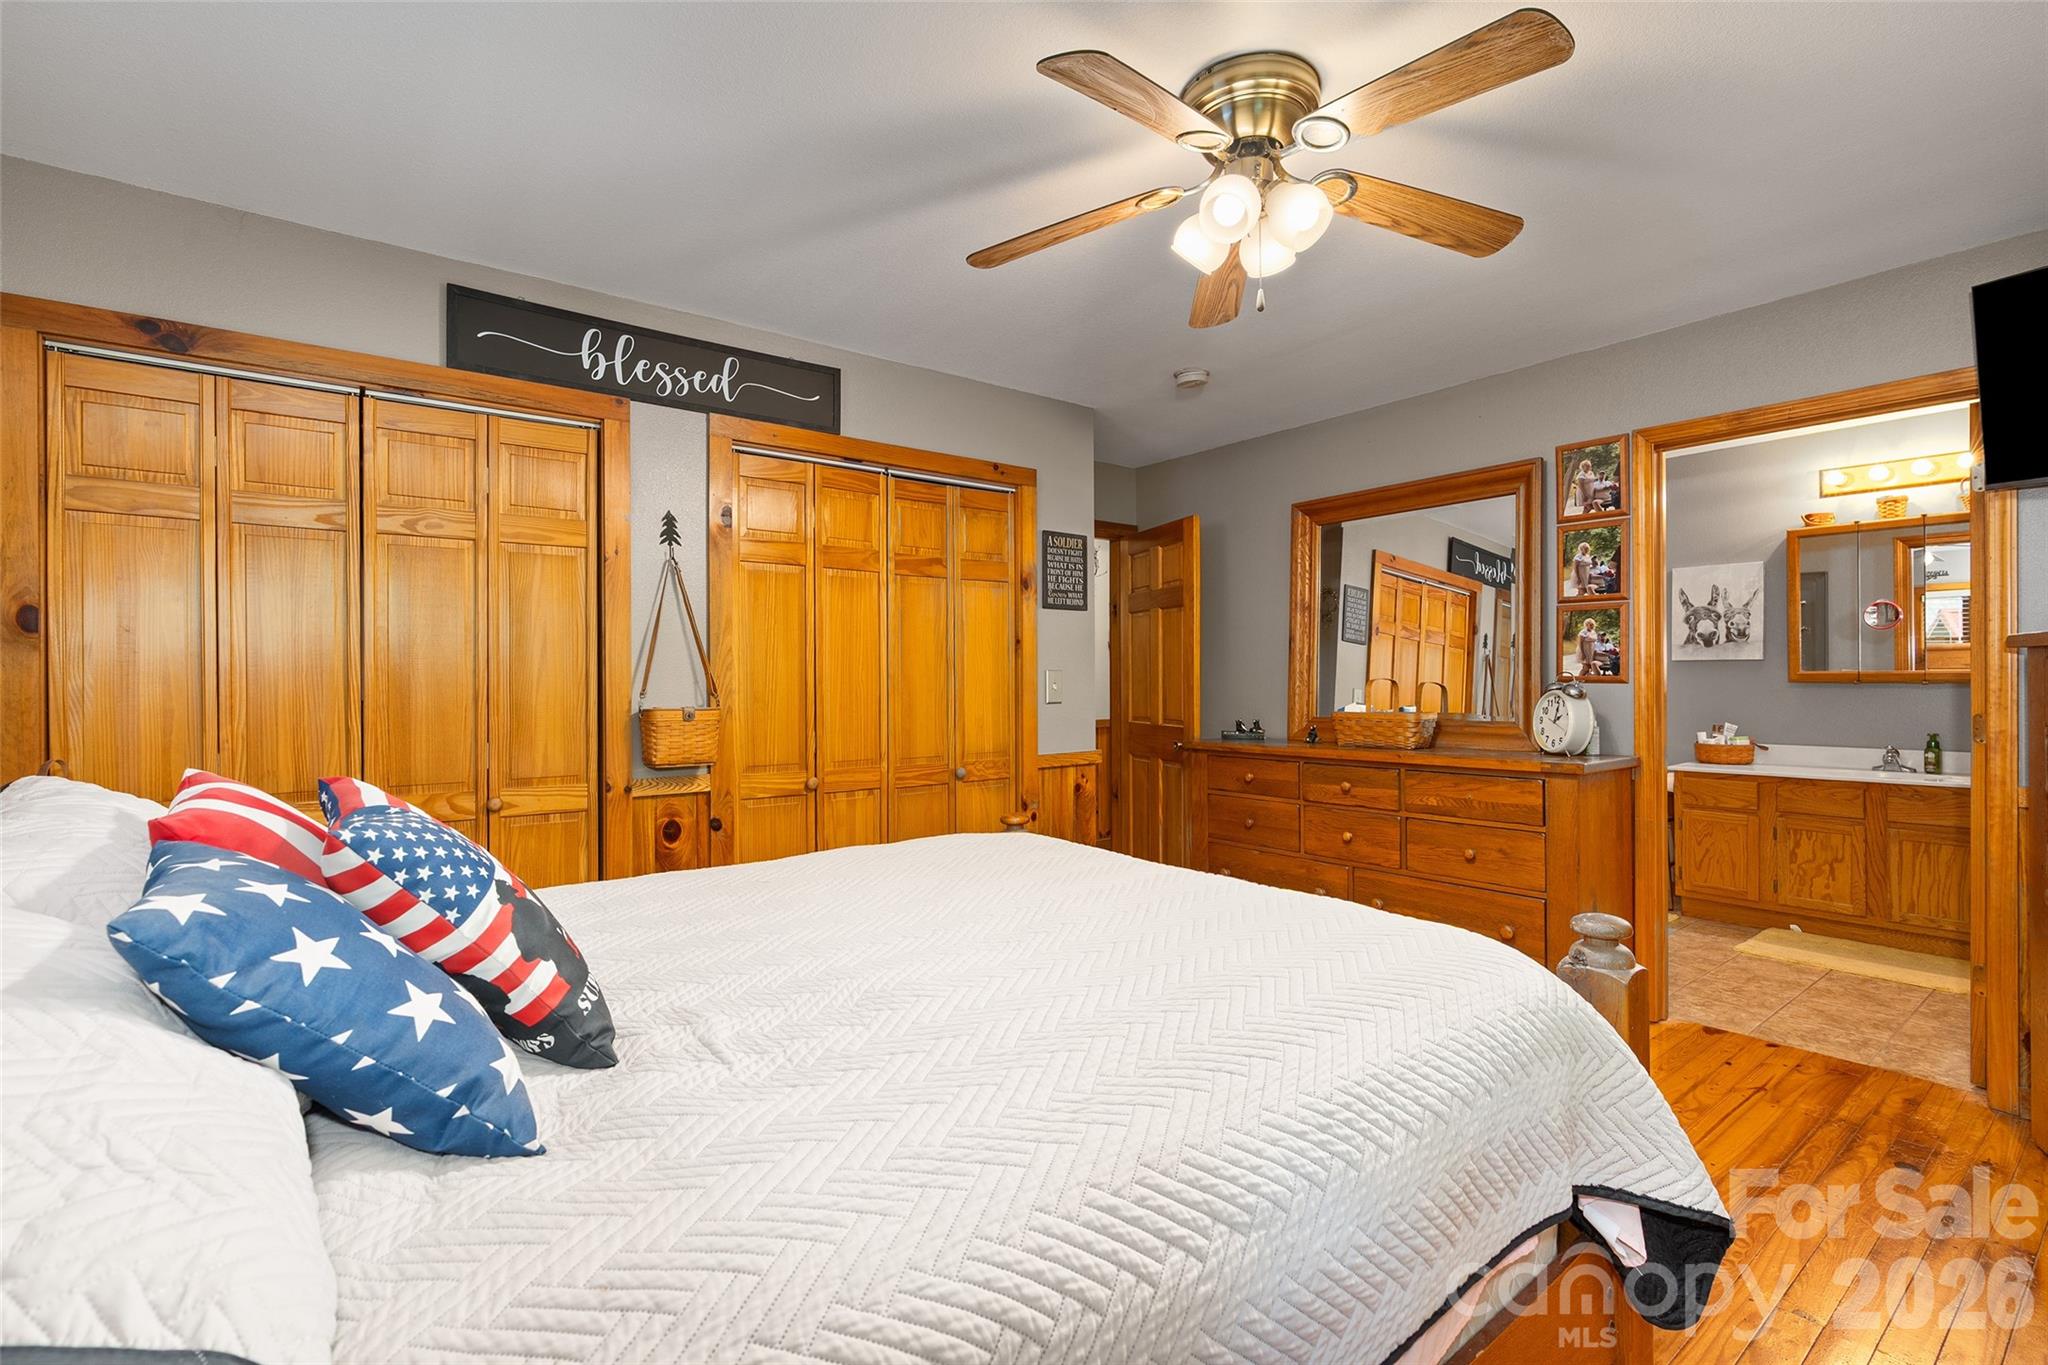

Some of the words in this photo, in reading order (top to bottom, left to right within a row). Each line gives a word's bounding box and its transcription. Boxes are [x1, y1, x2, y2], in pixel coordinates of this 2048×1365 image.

[1047, 536, 1053, 546] A
[1054, 536, 1083, 549] SOLDIER
[1048, 583, 1074, 591] BECAUSE
[1554, 696, 1561, 704] 12
[1542, 706, 1549, 715] 10
[1551, 739, 1556, 748] 6
